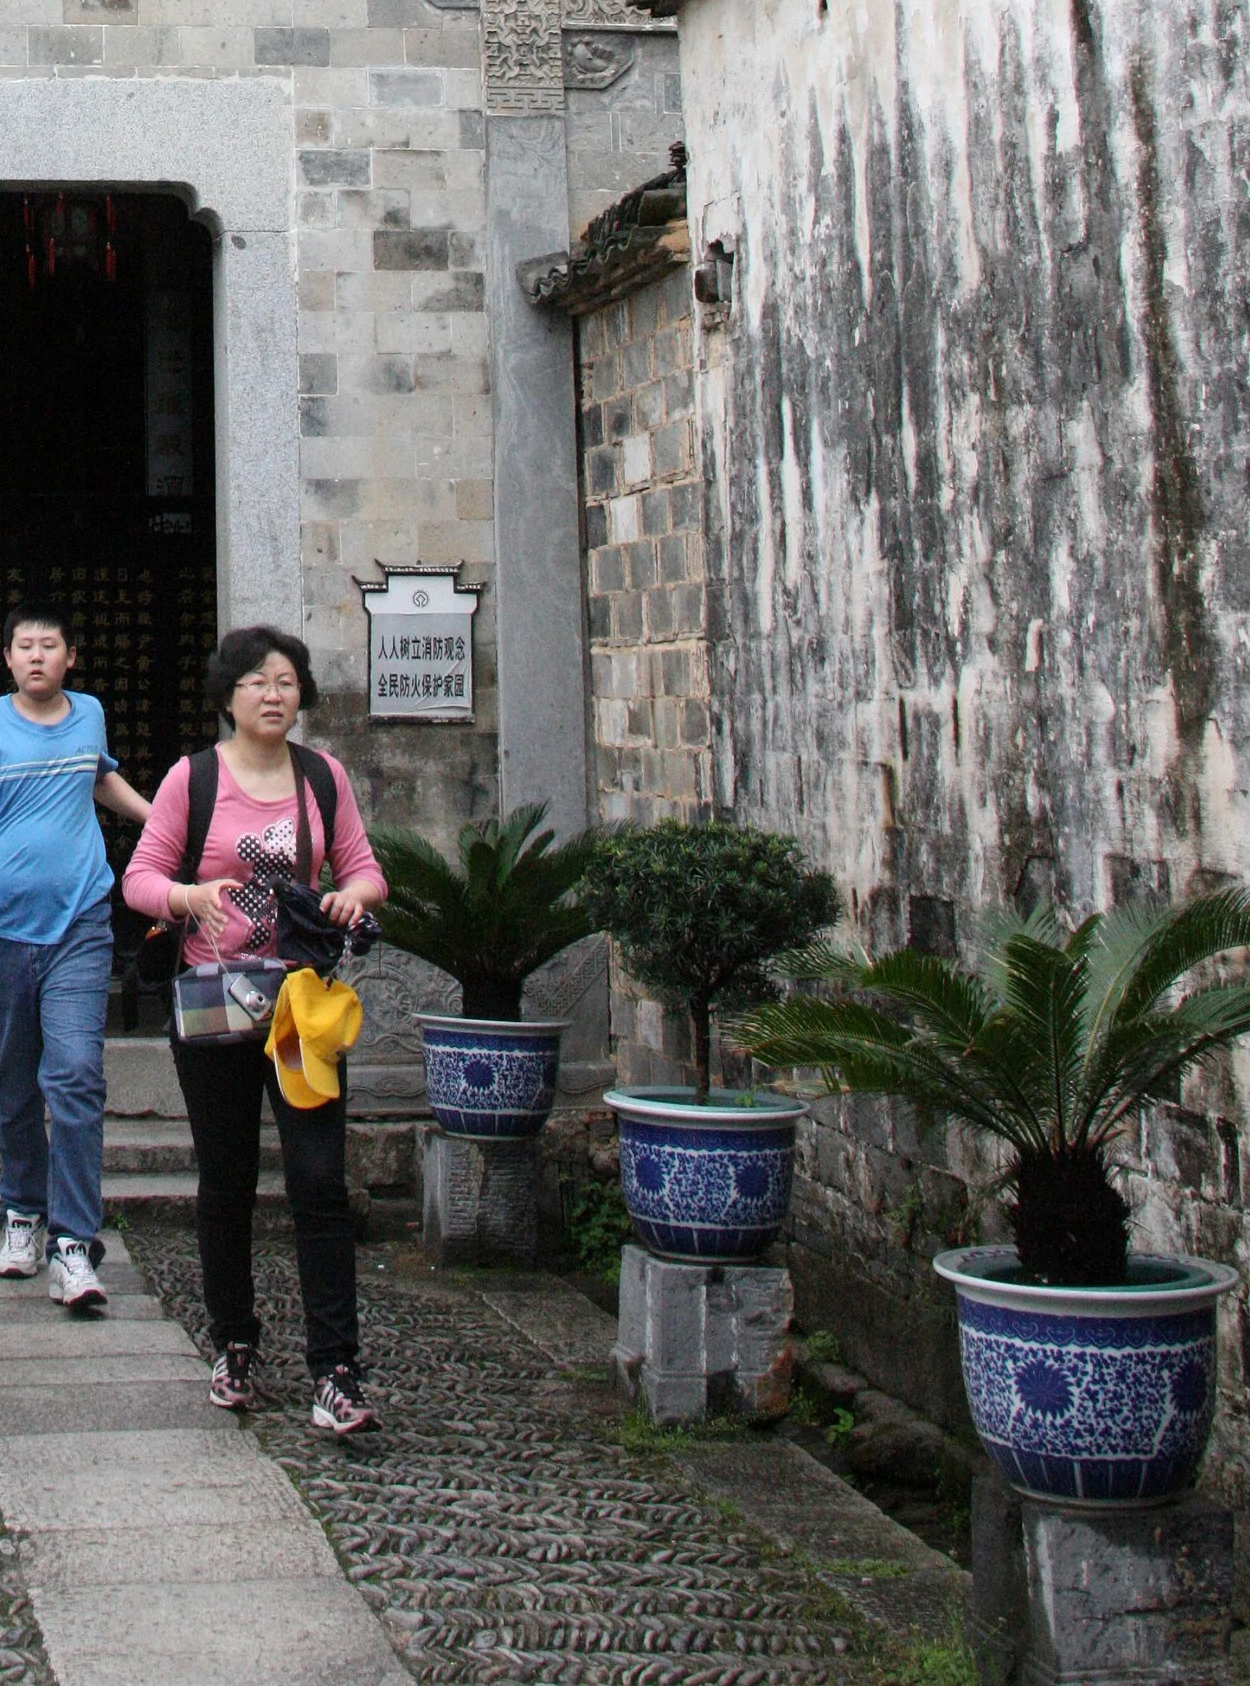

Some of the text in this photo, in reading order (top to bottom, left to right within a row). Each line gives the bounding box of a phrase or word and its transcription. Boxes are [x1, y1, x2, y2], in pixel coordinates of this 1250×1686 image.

[378, 635, 466, 660] 人人树立消防观念
[378, 674, 465, 698] 全民防火保护家园
